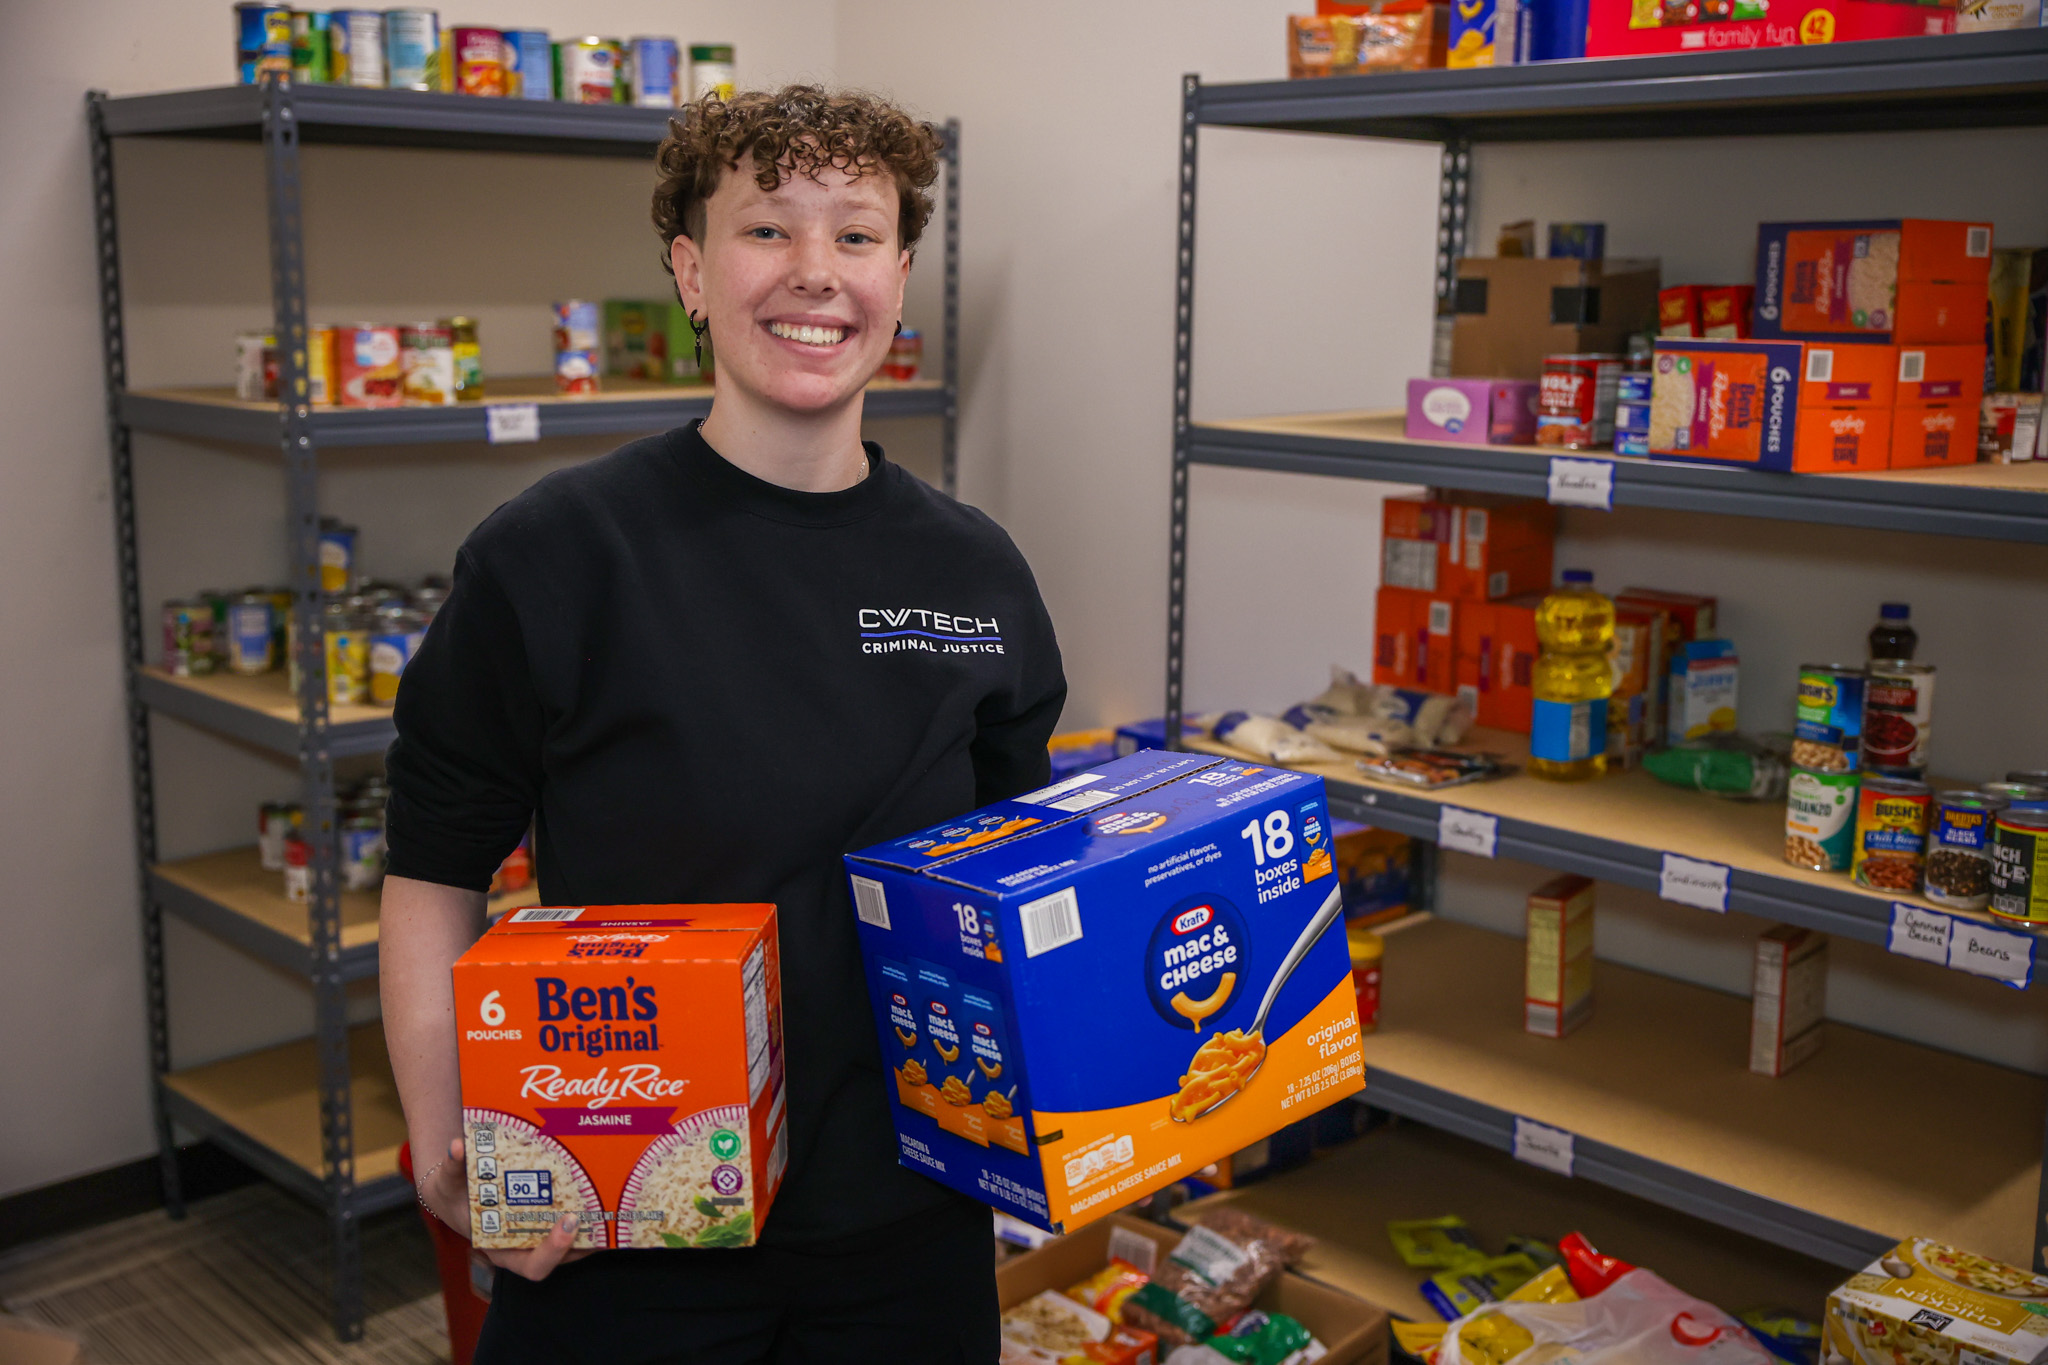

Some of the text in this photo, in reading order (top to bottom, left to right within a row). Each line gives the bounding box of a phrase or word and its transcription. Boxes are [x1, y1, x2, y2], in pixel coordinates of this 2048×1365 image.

[1707, 25, 1762, 49] family
[1765, 22, 1796, 47] fun
[1806, 16, 1826, 37] 42
[1767, 366, 1792, 452] 6 POUCHES
[862, 638, 1005, 655] CRIMINAL JUSTICE
[1109, 784, 1125, 792] DO
[1187, 771, 1227, 785] 18
[1876, 802, 1921, 819] BUSH'S
[1241, 809, 1294, 866] 18
[1148, 843, 1218, 874] no artificial flavors,
[1993, 843, 2021, 865] NCH
[1144, 850, 1222, 888] preservatives, or dyes
[1254, 858, 1298, 886] boxes
[1993, 858, 2026, 884] YLE
[1258, 875, 1301, 905] inside
[952, 902, 980, 935] 18
[1179, 911, 1205, 930] Kraft
[1904, 911, 1946, 935] Canned
[960, 931, 983, 947] boxes
[961, 941, 985, 959] inside
[1163, 924, 1230, 968] mac &
[1968, 938, 2010, 962] Beans
[566, 948, 645, 958] Ben's
[1160, 945, 1237, 991] cheese
[480, 990, 506, 1026] 6
[534, 976, 659, 1022] Ben's
[891, 1004, 914, 1021] mac &
[891, 1013, 917, 1031] cheese
[928, 1014, 956, 1032] mac &
[466, 1029, 523, 1041] POUCHES
[538, 1024, 660, 1057] Original
[928, 1024, 960, 1044] cheese
[1306, 1011, 1356, 1047] original
[972, 1034, 999, 1051] mac &
[972, 1044, 1002, 1062] cheese
[1318, 1032, 1358, 1059] flavor
[1287, 1083, 1295, 1094] 18
[1299, 1075, 1312, 1088] 7.25
[1312, 1069, 1321, 1082] OZ
[1339, 1050, 1361, 1069] BOXES
[1281, 1095, 1294, 1110] NET
[1294, 1089, 1306, 1103] WT
[1306, 1088, 1311, 1098] 8
[1311, 1083, 1320, 1095] LB
[1320, 1078, 1330, 1091] 2.5
[1330, 1073, 1339, 1086] OZ
[577, 1114, 632, 1126] JASMINE
[477, 1132, 493, 1142] 250
[902, 1144, 920, 1162] CHEESE
[919, 1154, 936, 1168] SAUCE
[512, 1183, 531, 1195] 90
[978, 1177, 990, 1191] NET
[1070, 1188, 1110, 1215] MACARONI
[1109, 1185, 1117, 1196] &
[1116, 1171, 1144, 1193] CHEESE
[1143, 1160, 1168, 1180] SAUCE
[1167, 1153, 1182, 1168] MIX
[526, 1212, 535, 1221] OZ
[1895, 1286, 2002, 1327] CHICKEN
